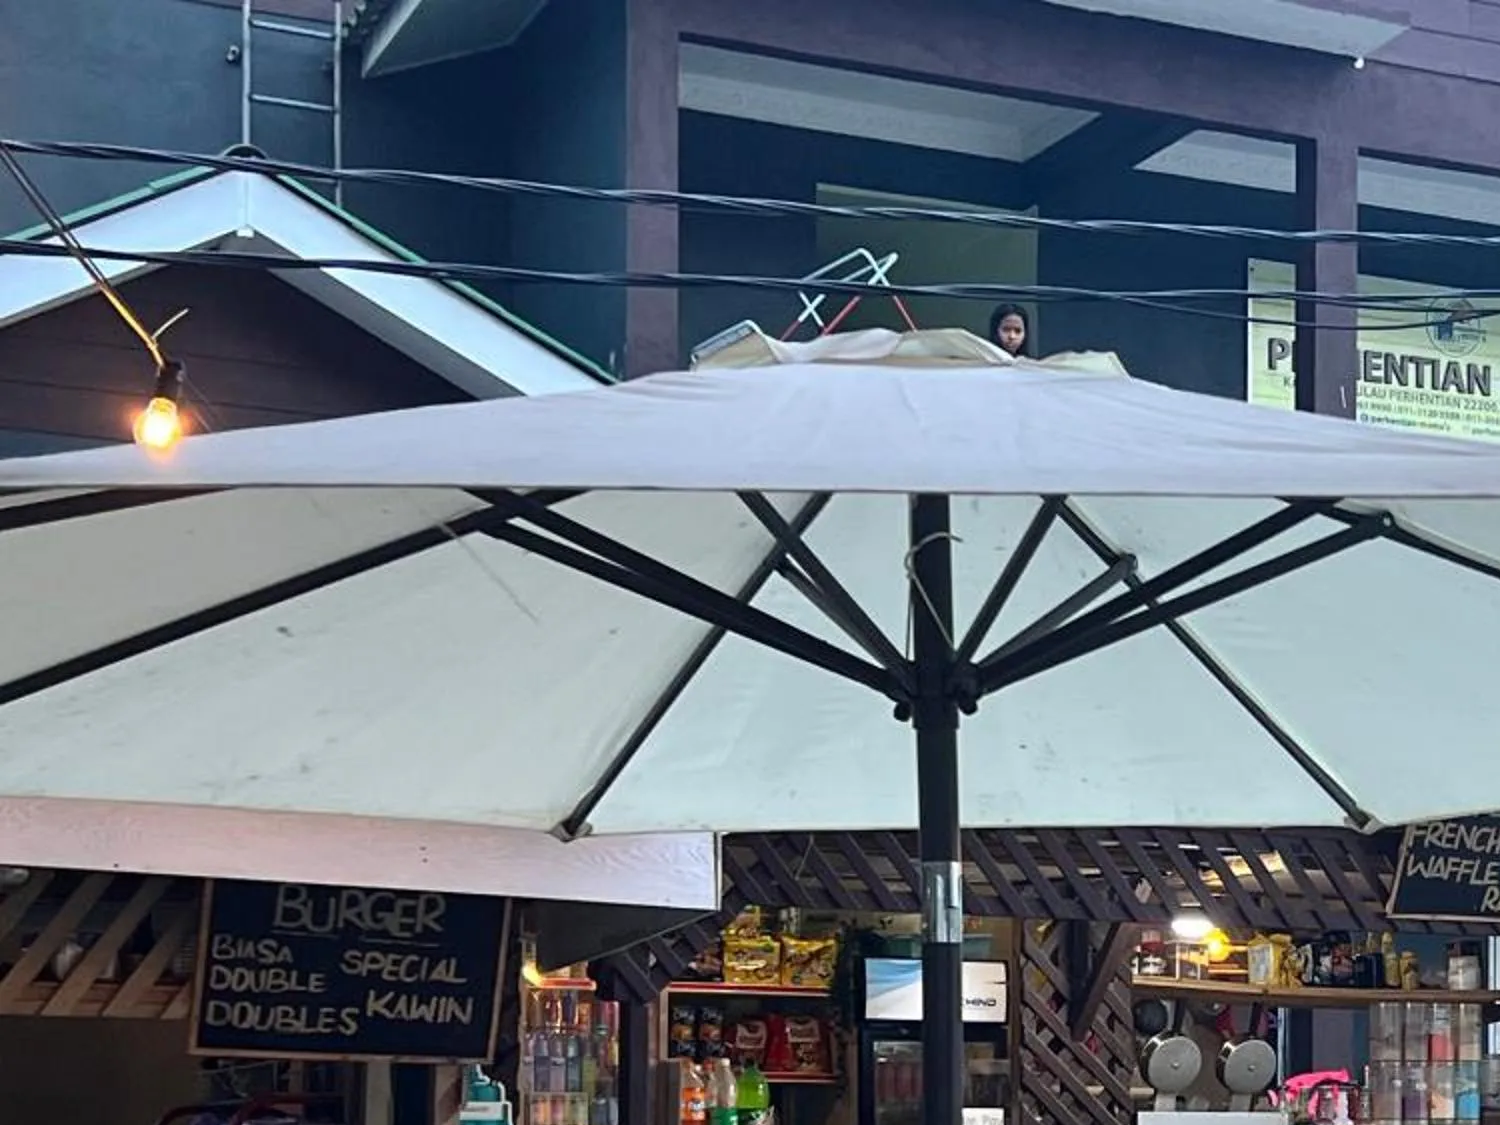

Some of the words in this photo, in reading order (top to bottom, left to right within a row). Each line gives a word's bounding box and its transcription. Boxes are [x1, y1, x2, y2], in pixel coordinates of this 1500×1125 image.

[1267, 337, 1491, 397] PENTIAN
[1389, 388, 1461, 409] PERHENTIAN
[1407, 854, 1500, 885] WAFFLE
[272, 883, 446, 937] BURGER
[211, 934, 294, 964] BIASA
[340, 949, 467, 984] SPECIAL
[209, 965, 326, 993] DOUBLE
[206, 1000, 359, 1035] DOUBLES
[366, 989, 474, 1025] KAWIN
